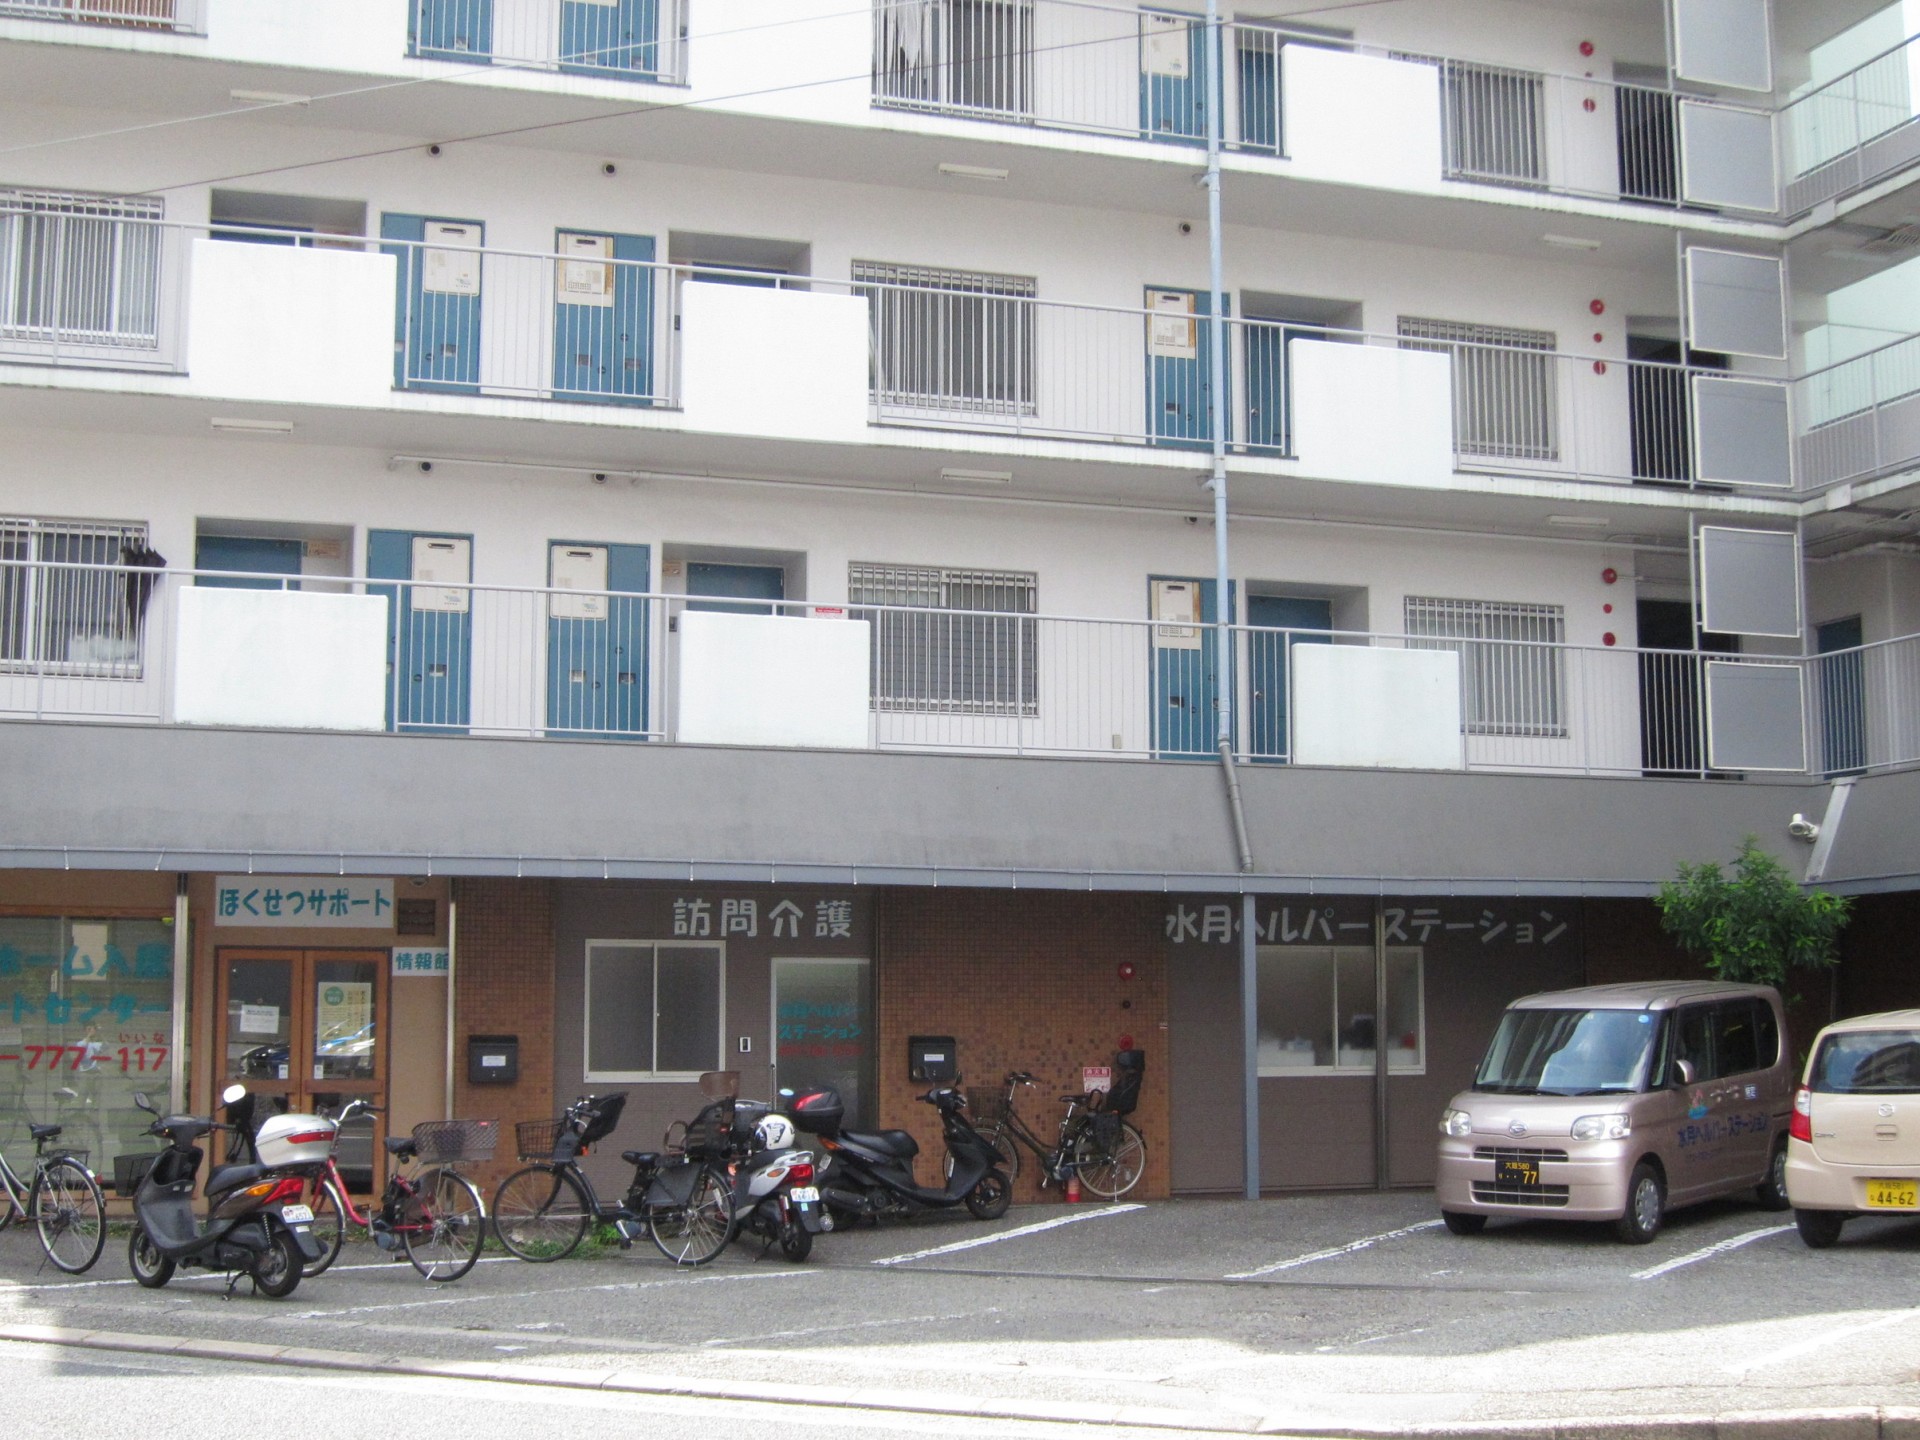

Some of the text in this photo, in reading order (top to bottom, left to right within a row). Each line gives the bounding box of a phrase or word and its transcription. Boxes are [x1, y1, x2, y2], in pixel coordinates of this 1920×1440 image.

[219, 888, 391, 917] ほくせつサポート
[673, 898, 852, 938] 訪問介護
[0, 991, 168, 1025] トセンター
[119, 1032, 165, 1044] いいな
[1876, 1192, 1915, 1206] 44-62
